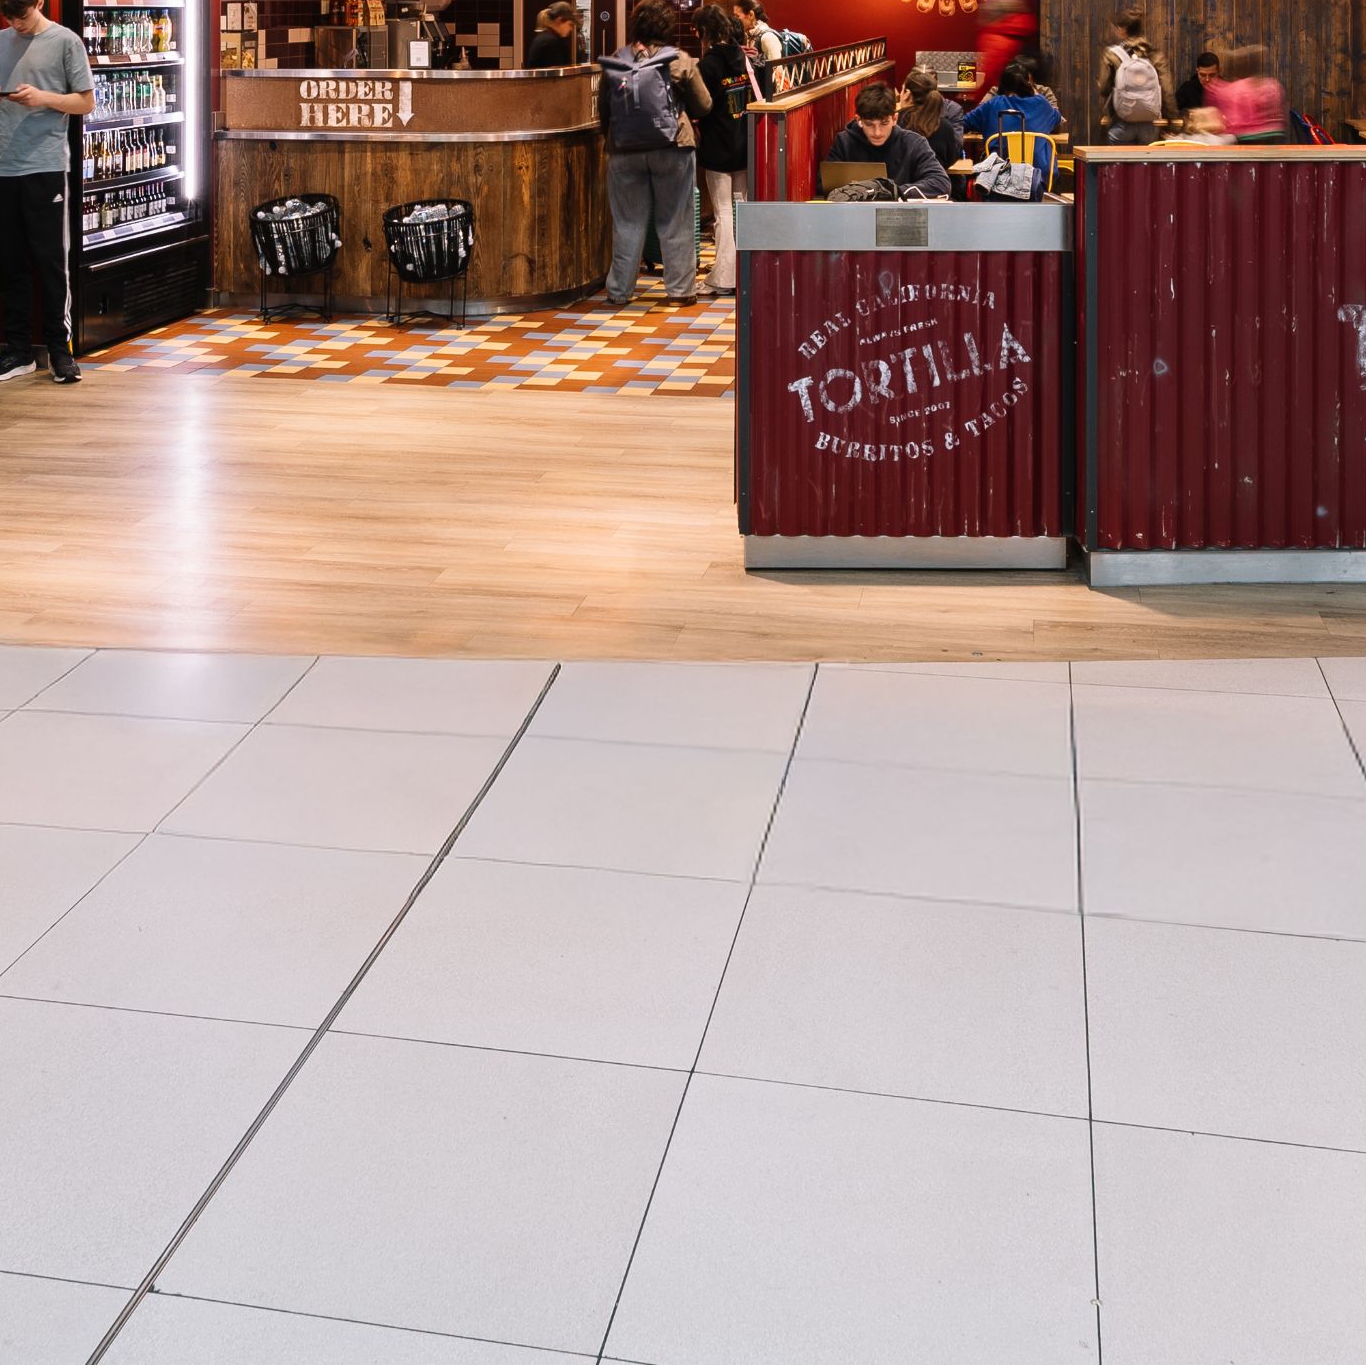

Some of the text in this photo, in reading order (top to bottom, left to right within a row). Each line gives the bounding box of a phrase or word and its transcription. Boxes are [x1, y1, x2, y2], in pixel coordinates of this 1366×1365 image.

[299, 79, 394, 100] ORDER
[299, 103, 393, 128] HERE
[797, 311, 851, 360] REAL
[787, 322, 1033, 423] TORTILLA
[814, 376, 1030, 462] BURRITOS & TACOS
[889, 400, 952, 424] SINCE 2007
